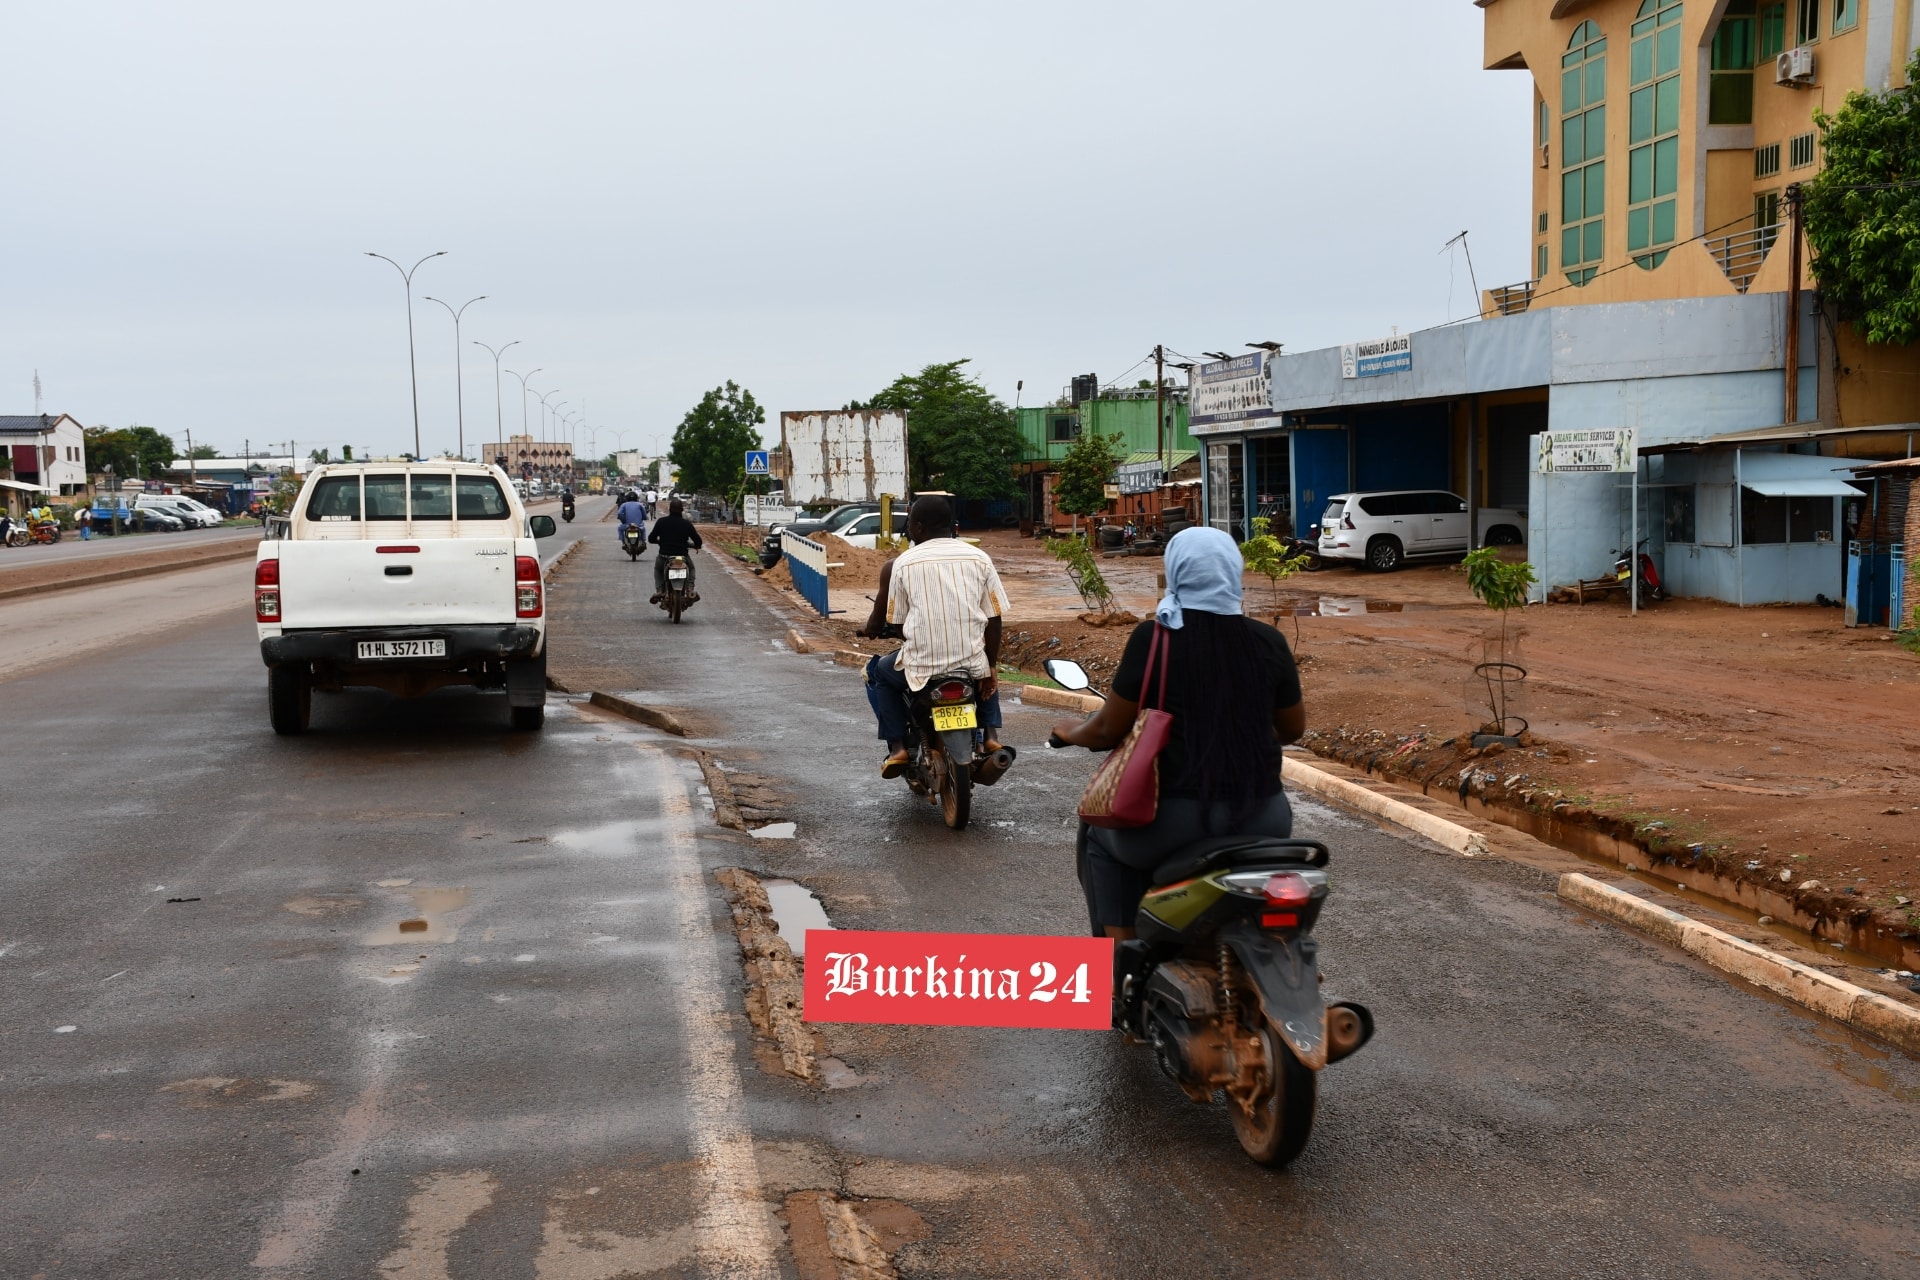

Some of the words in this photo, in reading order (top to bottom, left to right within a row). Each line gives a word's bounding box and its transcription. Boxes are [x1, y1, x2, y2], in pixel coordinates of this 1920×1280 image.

[1359, 343, 1384, 356] IMMEUBLE
[1205, 364, 1223, 374] GLOBAL
[1224, 360, 1236, 371] AUTO
[1590, 431, 1615, 441] SERVICES
[391, 642, 419, 656] 3572
[940, 706, 963, 718] 8622
